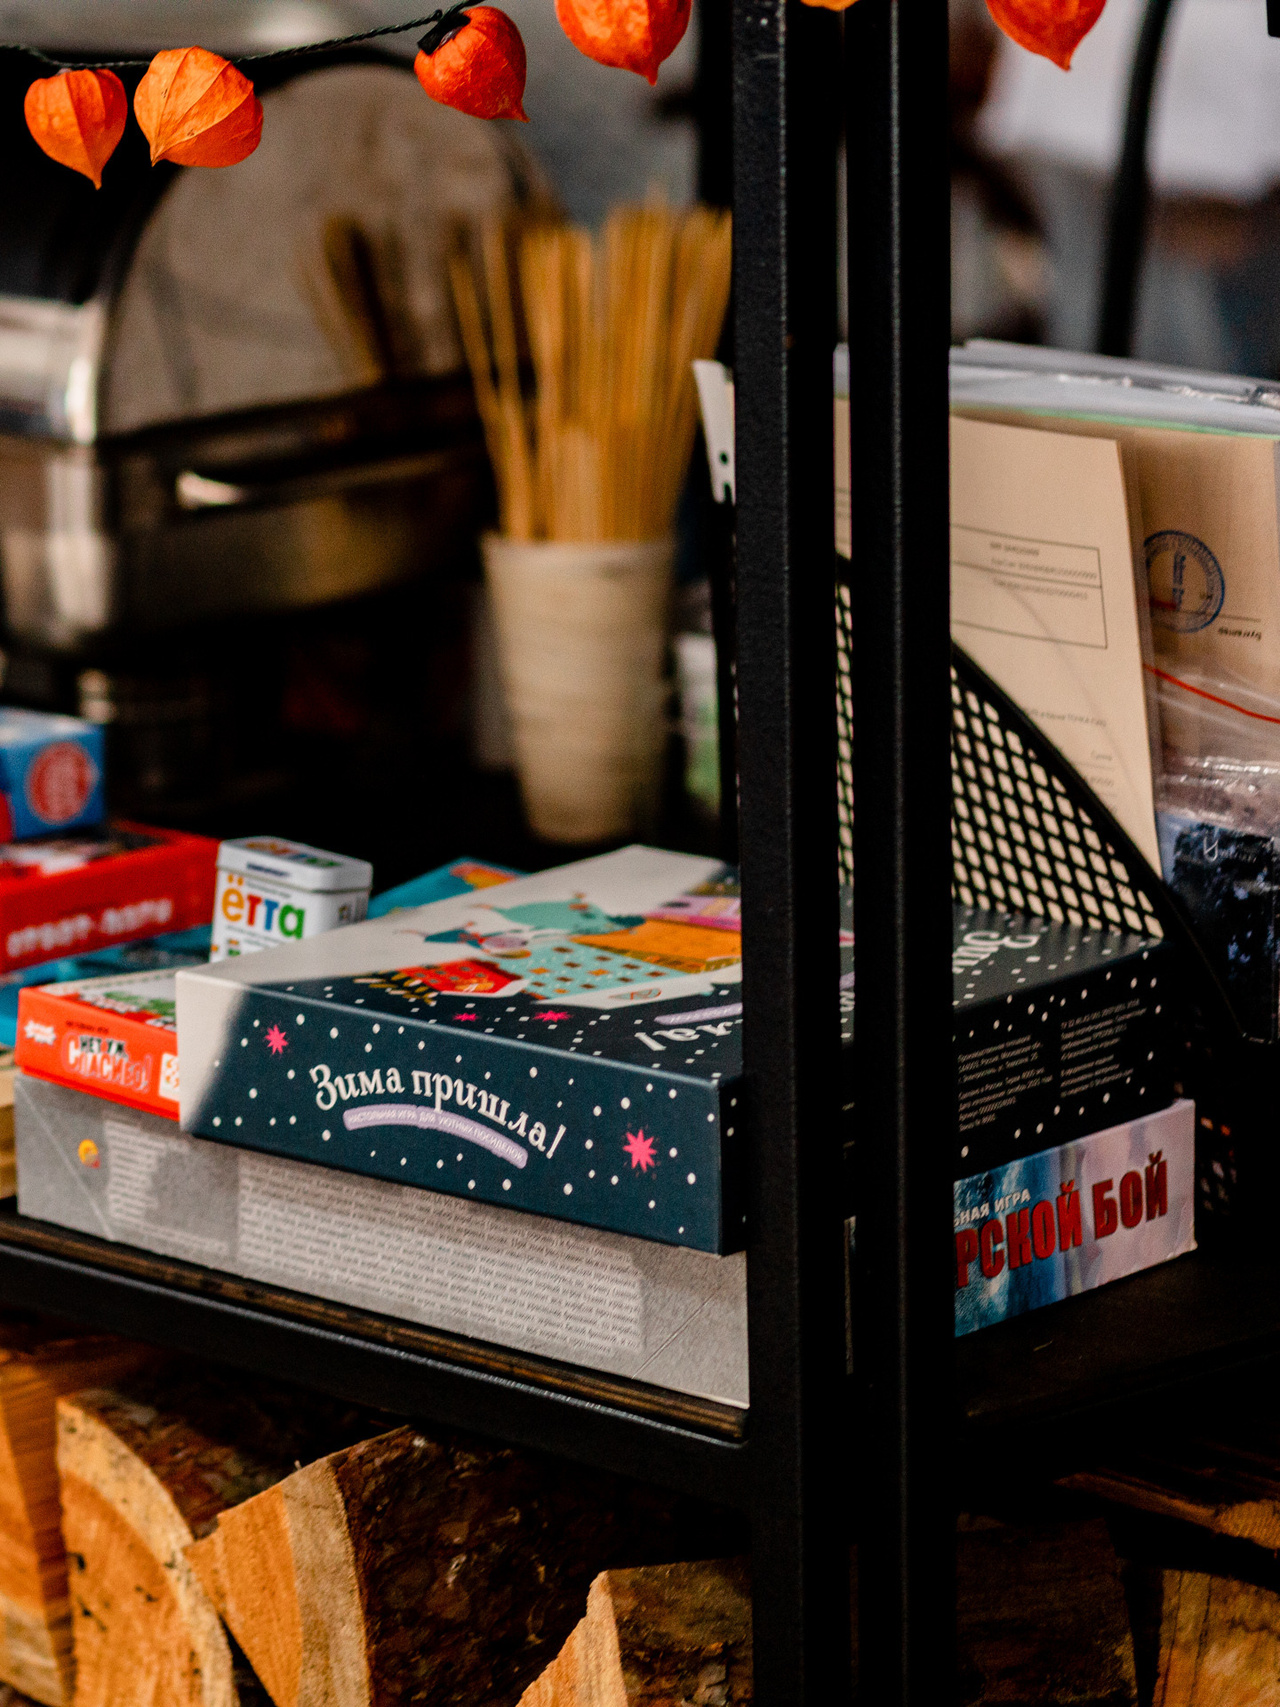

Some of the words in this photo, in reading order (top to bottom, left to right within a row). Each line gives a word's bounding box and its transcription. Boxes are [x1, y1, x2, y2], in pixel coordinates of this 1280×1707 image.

[309, 1063, 405, 1111] Зима
[411, 1069, 567, 1160] пришла!
[956, 1178, 1084, 1290] РСКОЙ
[1093, 1150, 1170, 1241] БОЙ
[994, 1187, 1031, 1214] ИГРА
